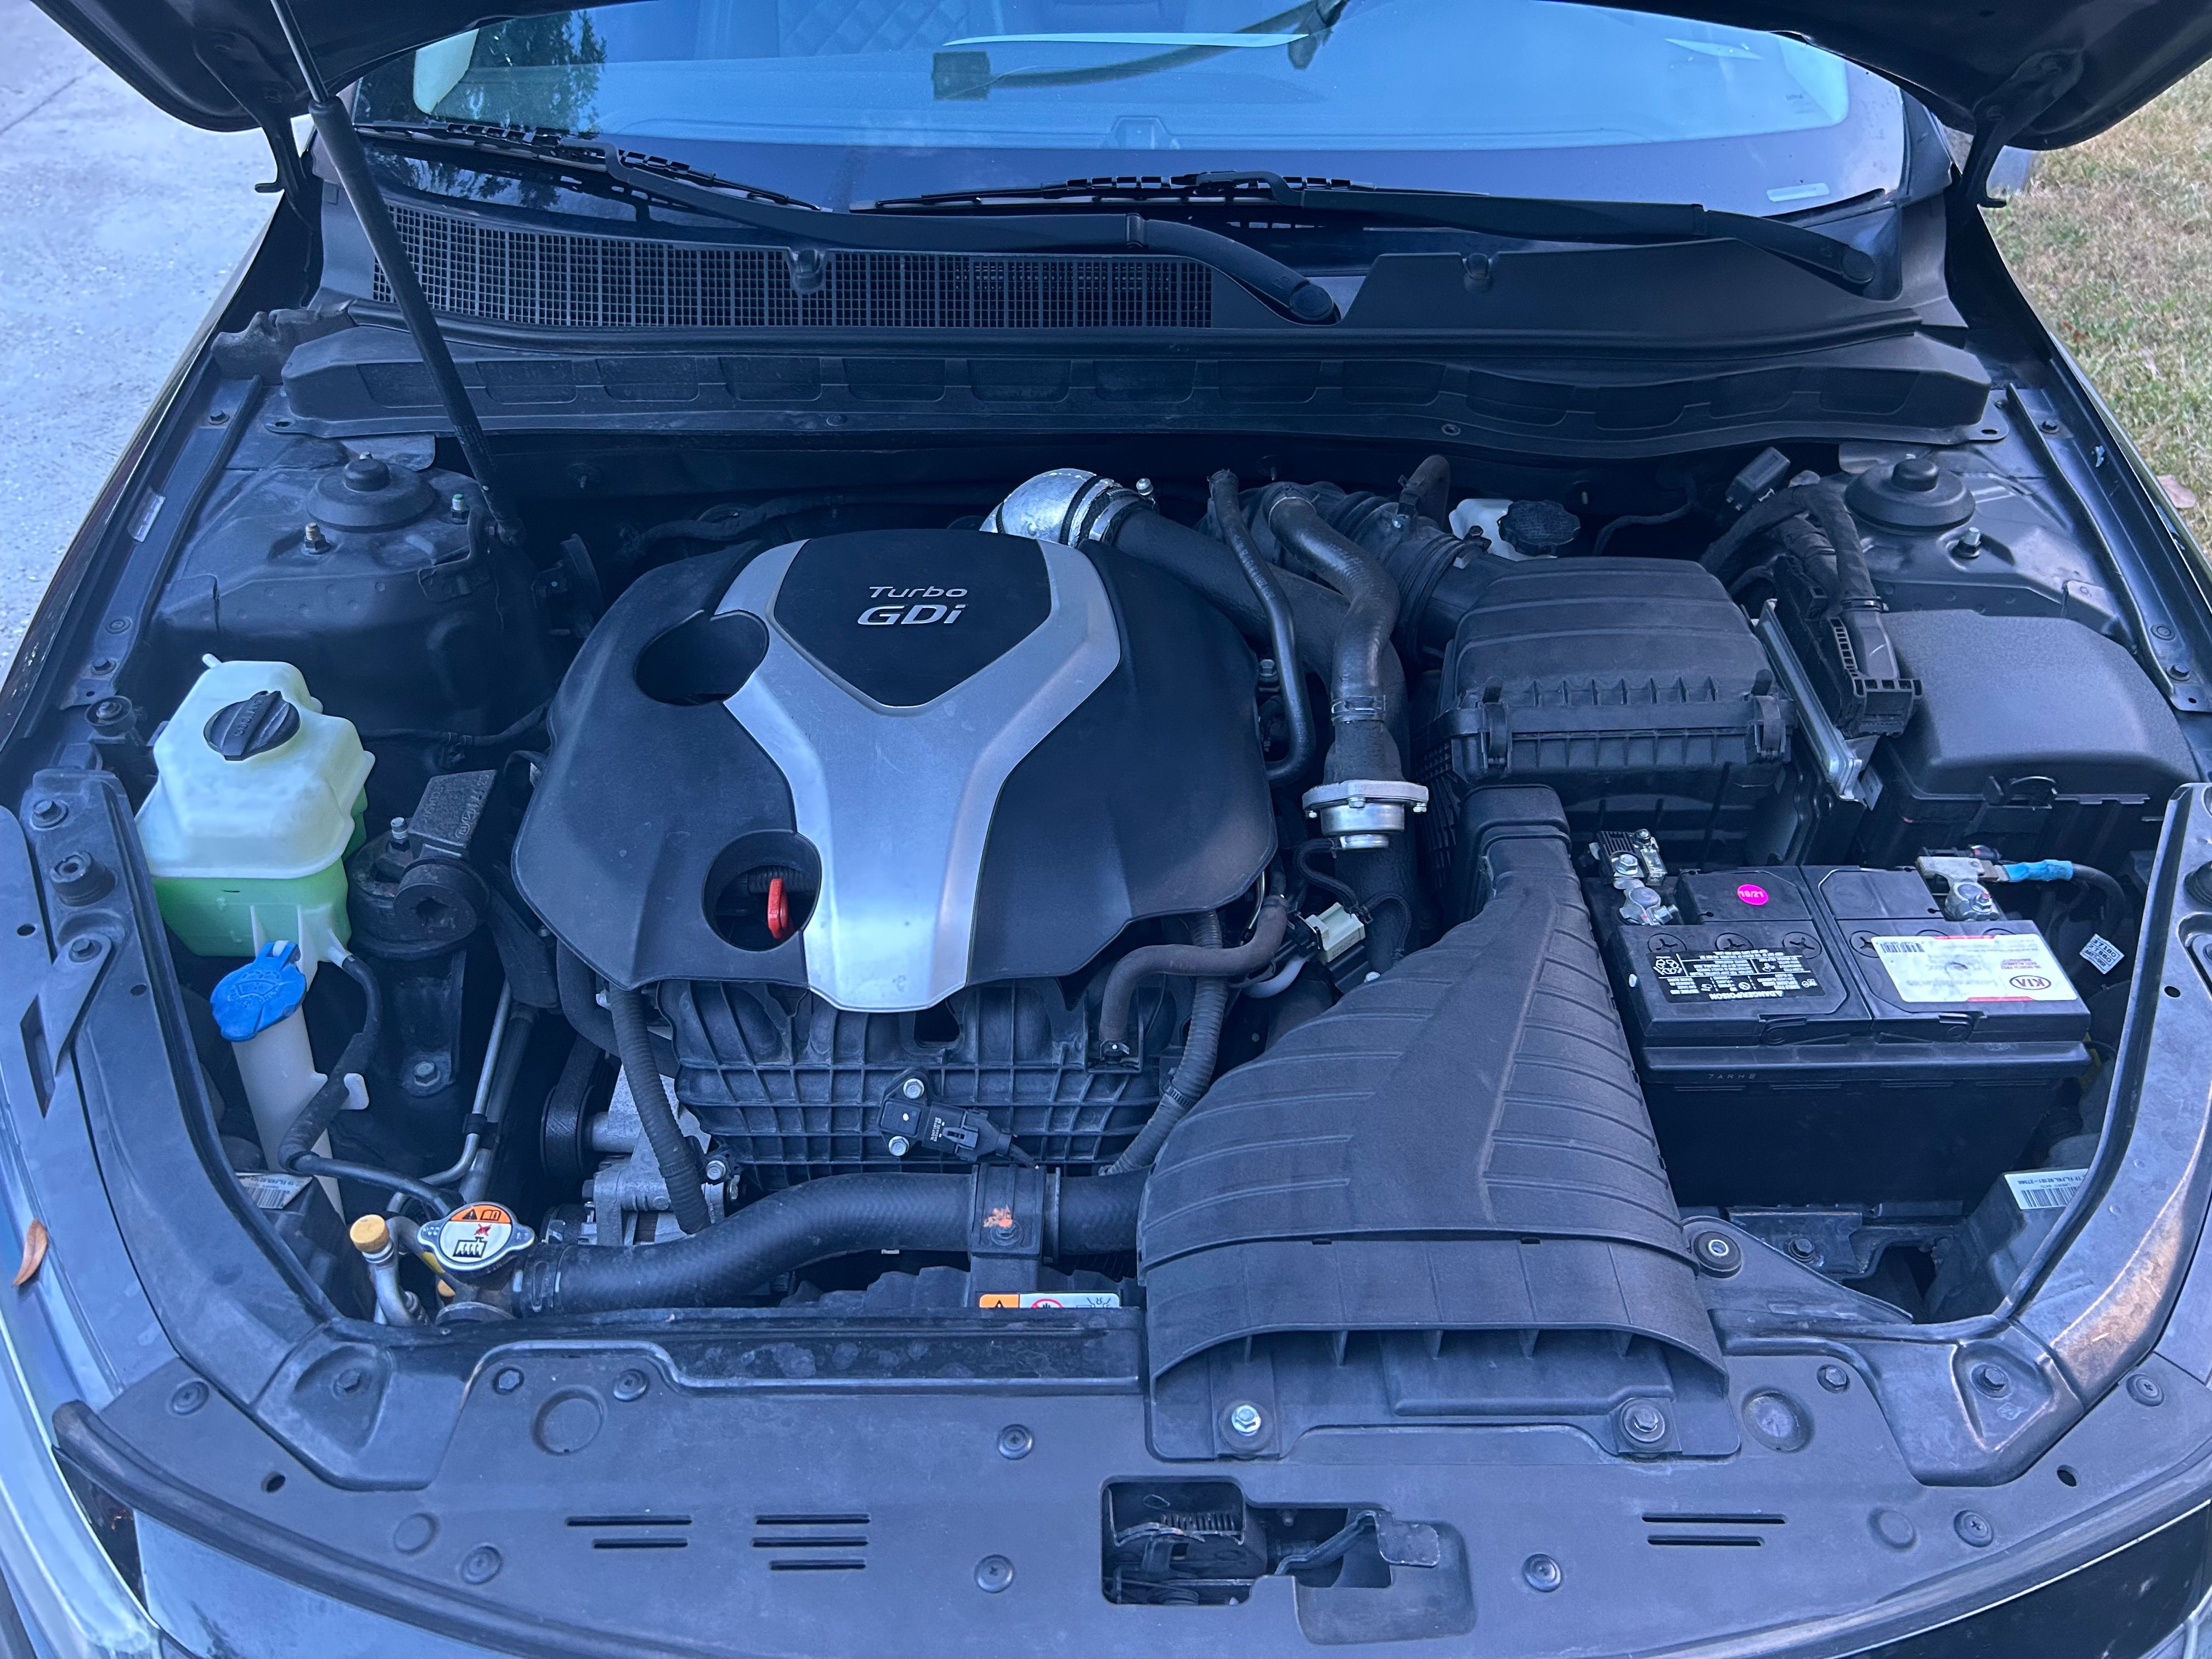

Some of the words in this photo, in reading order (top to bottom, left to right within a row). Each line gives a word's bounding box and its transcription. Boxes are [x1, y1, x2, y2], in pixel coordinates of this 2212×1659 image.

[868, 585, 968, 599] Turbo
[857, 604, 967, 625] GDi
[1739, 890, 1764, 899] 10/21
[2092, 939, 2117, 958] 37180
[2016, 977, 2045, 987] KIA
